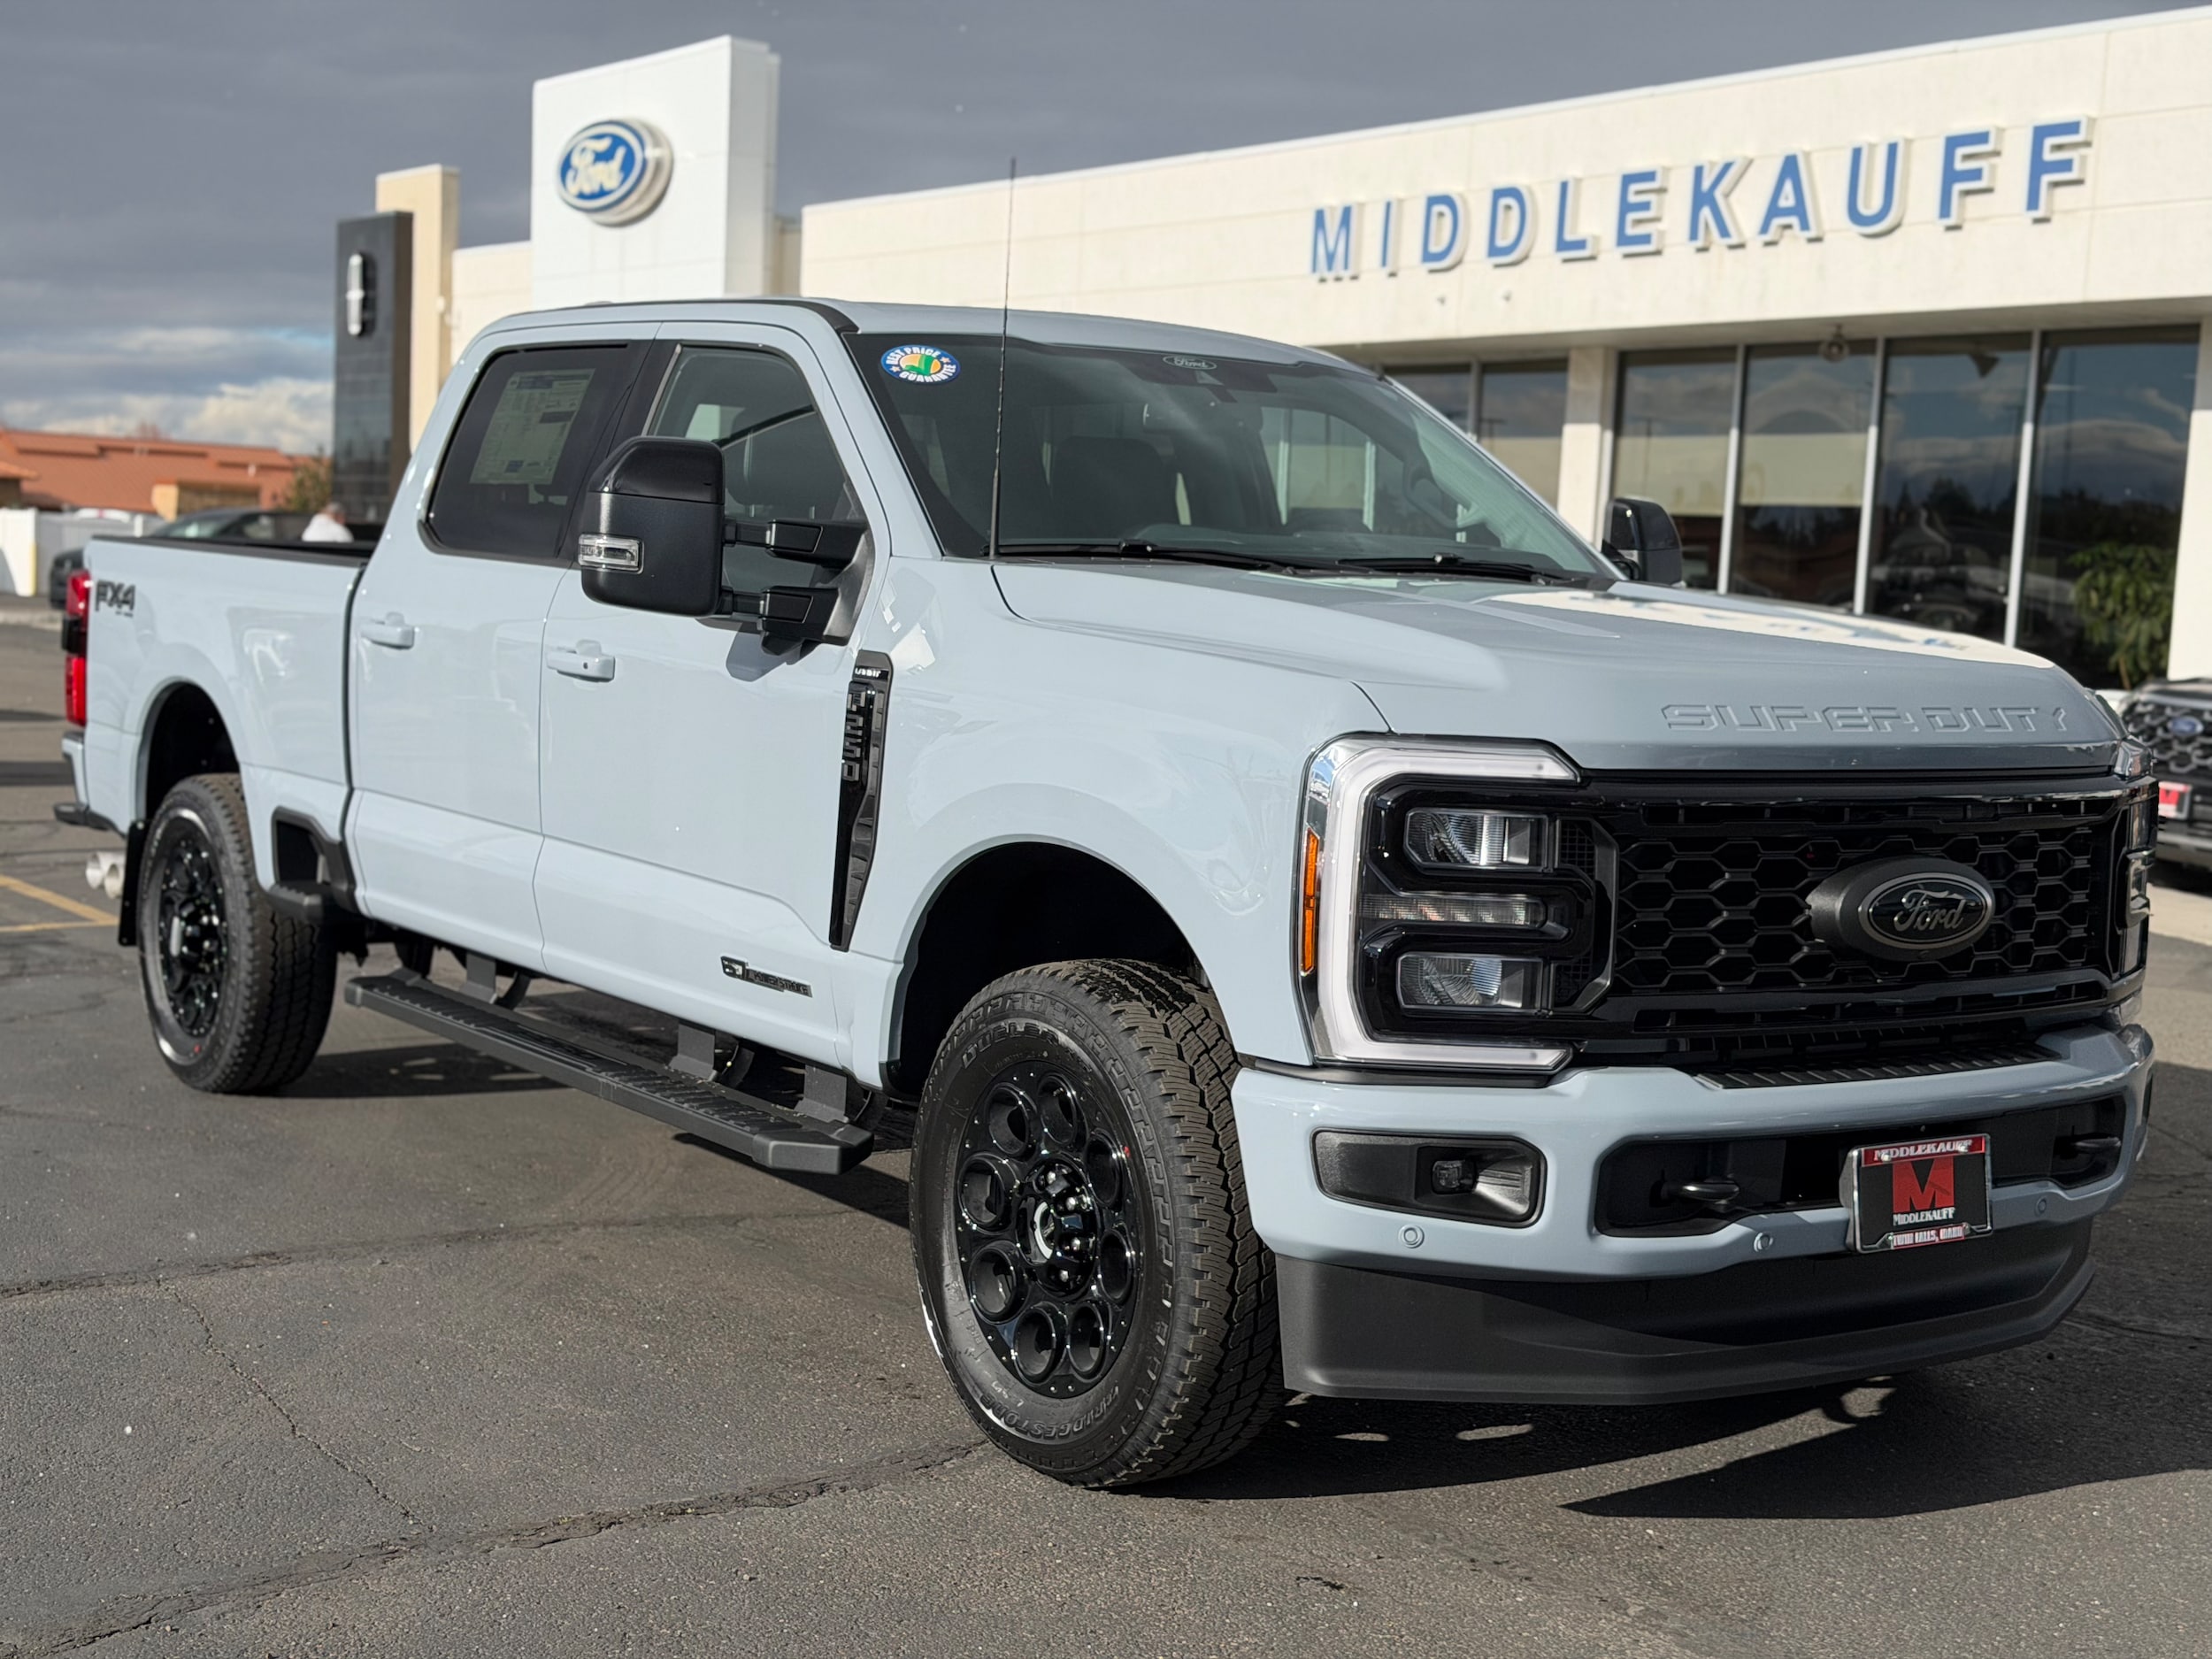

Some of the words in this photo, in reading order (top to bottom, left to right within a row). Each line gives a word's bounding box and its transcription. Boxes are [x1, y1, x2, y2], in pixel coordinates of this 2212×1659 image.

[565, 135, 627, 196] Ford
[1311, 116, 2090, 280] MIDDLEKAUFF
[886, 348, 905, 365] BEST
[903, 346, 941, 357] PRICE
[1173, 356, 1209, 368] Ford
[899, 364, 956, 382] GUARANTEE
[95, 580, 135, 611] FX4
[1661, 704, 1920, 733] SUPER
[1920, 706, 2068, 733] DUTY
[1893, 888, 1966, 932] Ford
[962, 1021, 1060, 1070] DUELER
[1892, 1155, 1955, 1214] M
[1892, 1206, 1956, 1226] MIDDLEKAUFF
